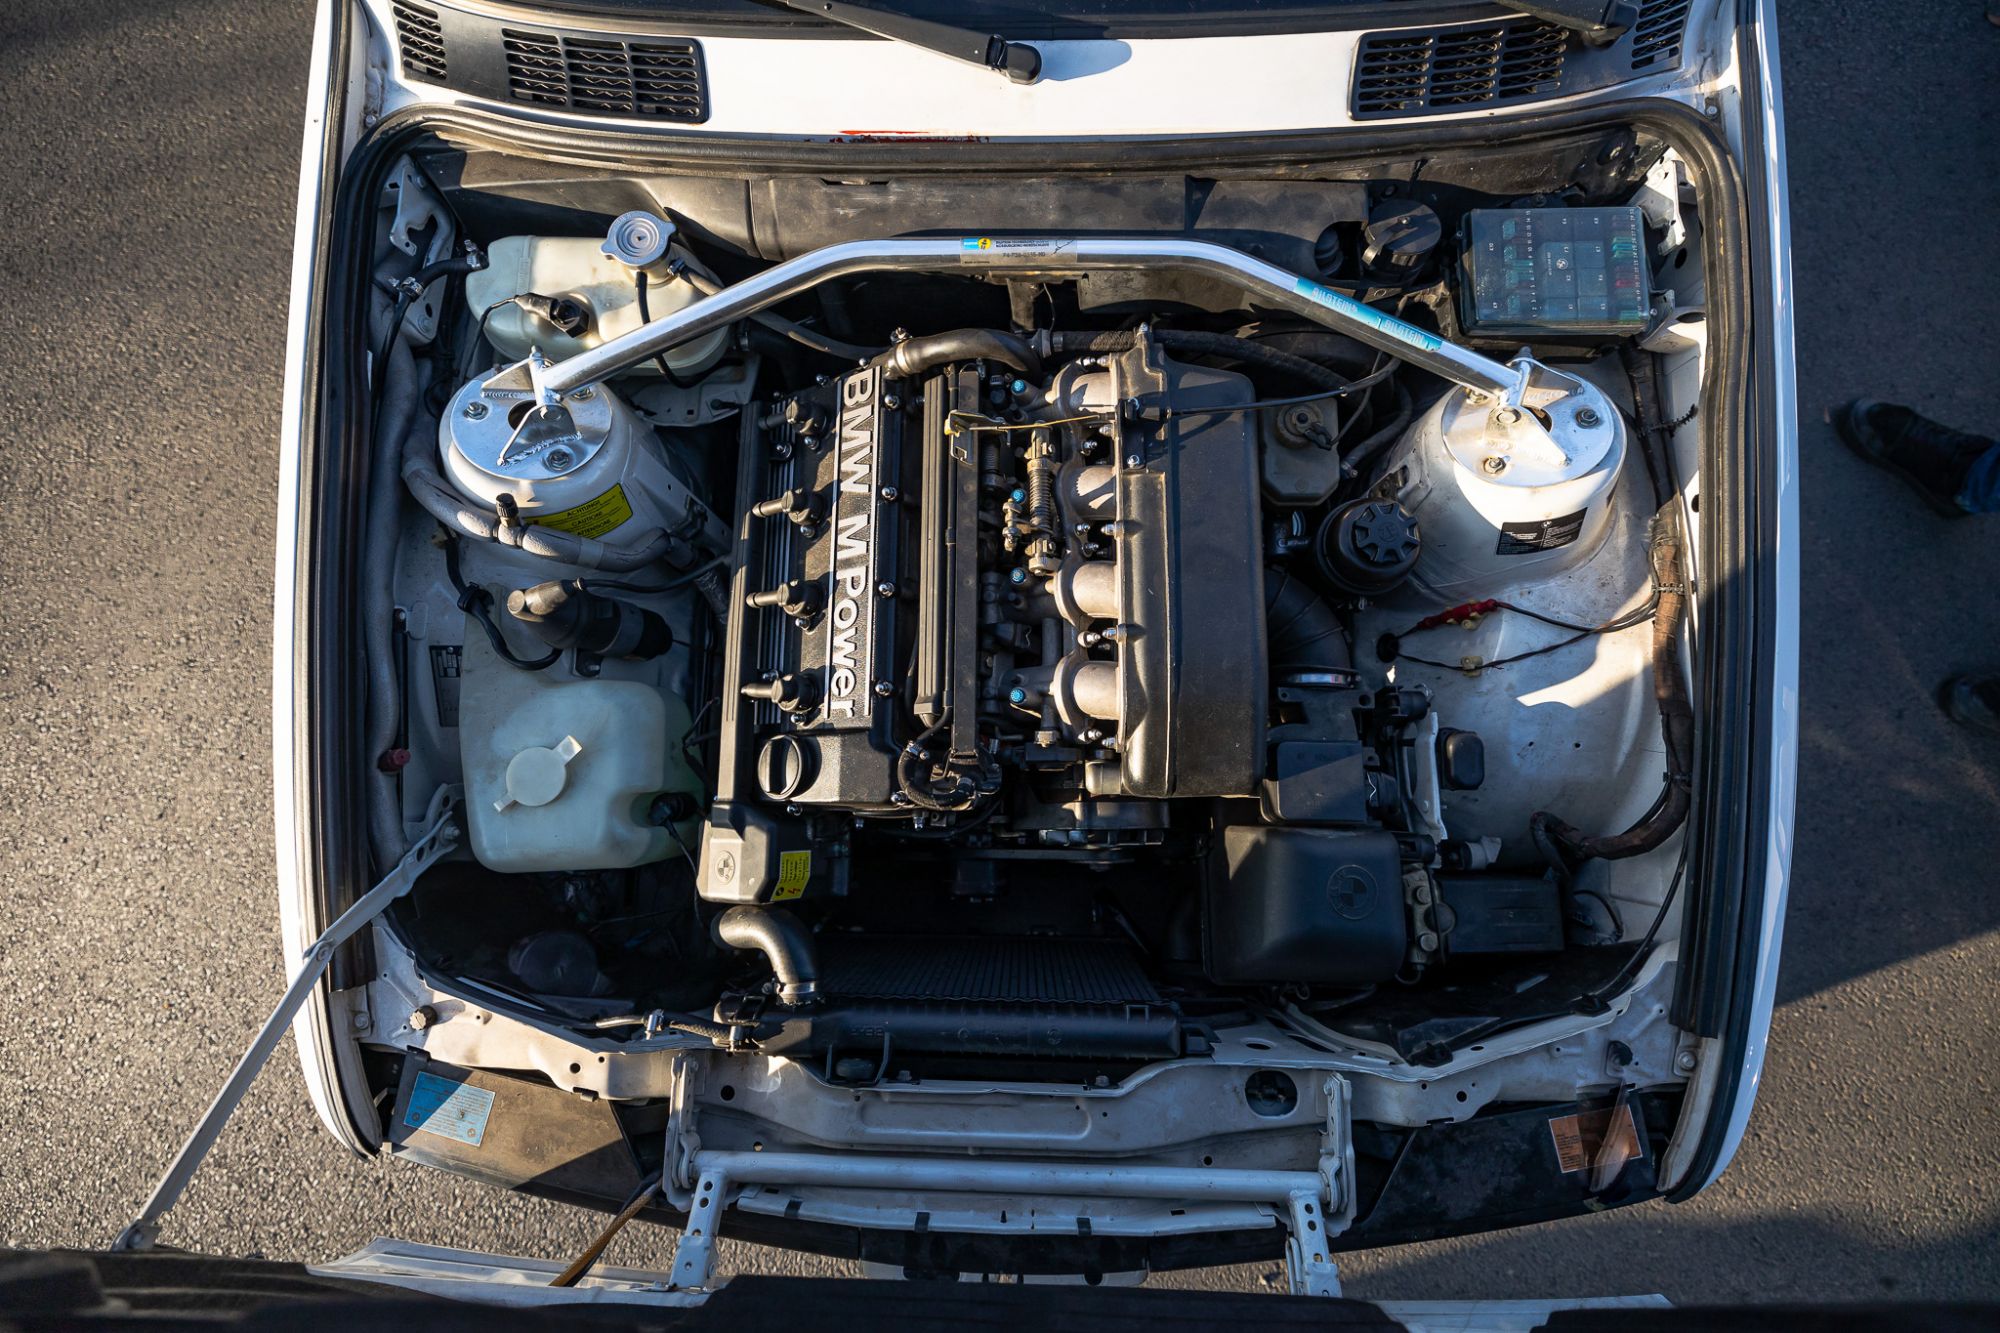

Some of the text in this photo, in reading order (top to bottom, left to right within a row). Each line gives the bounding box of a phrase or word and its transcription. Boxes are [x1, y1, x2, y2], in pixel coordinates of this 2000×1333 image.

[1312, 287, 1351, 313] BILSTEIN
[1383, 319, 1424, 343] BILSTEIN
[840, 368, 873, 493] BMW
